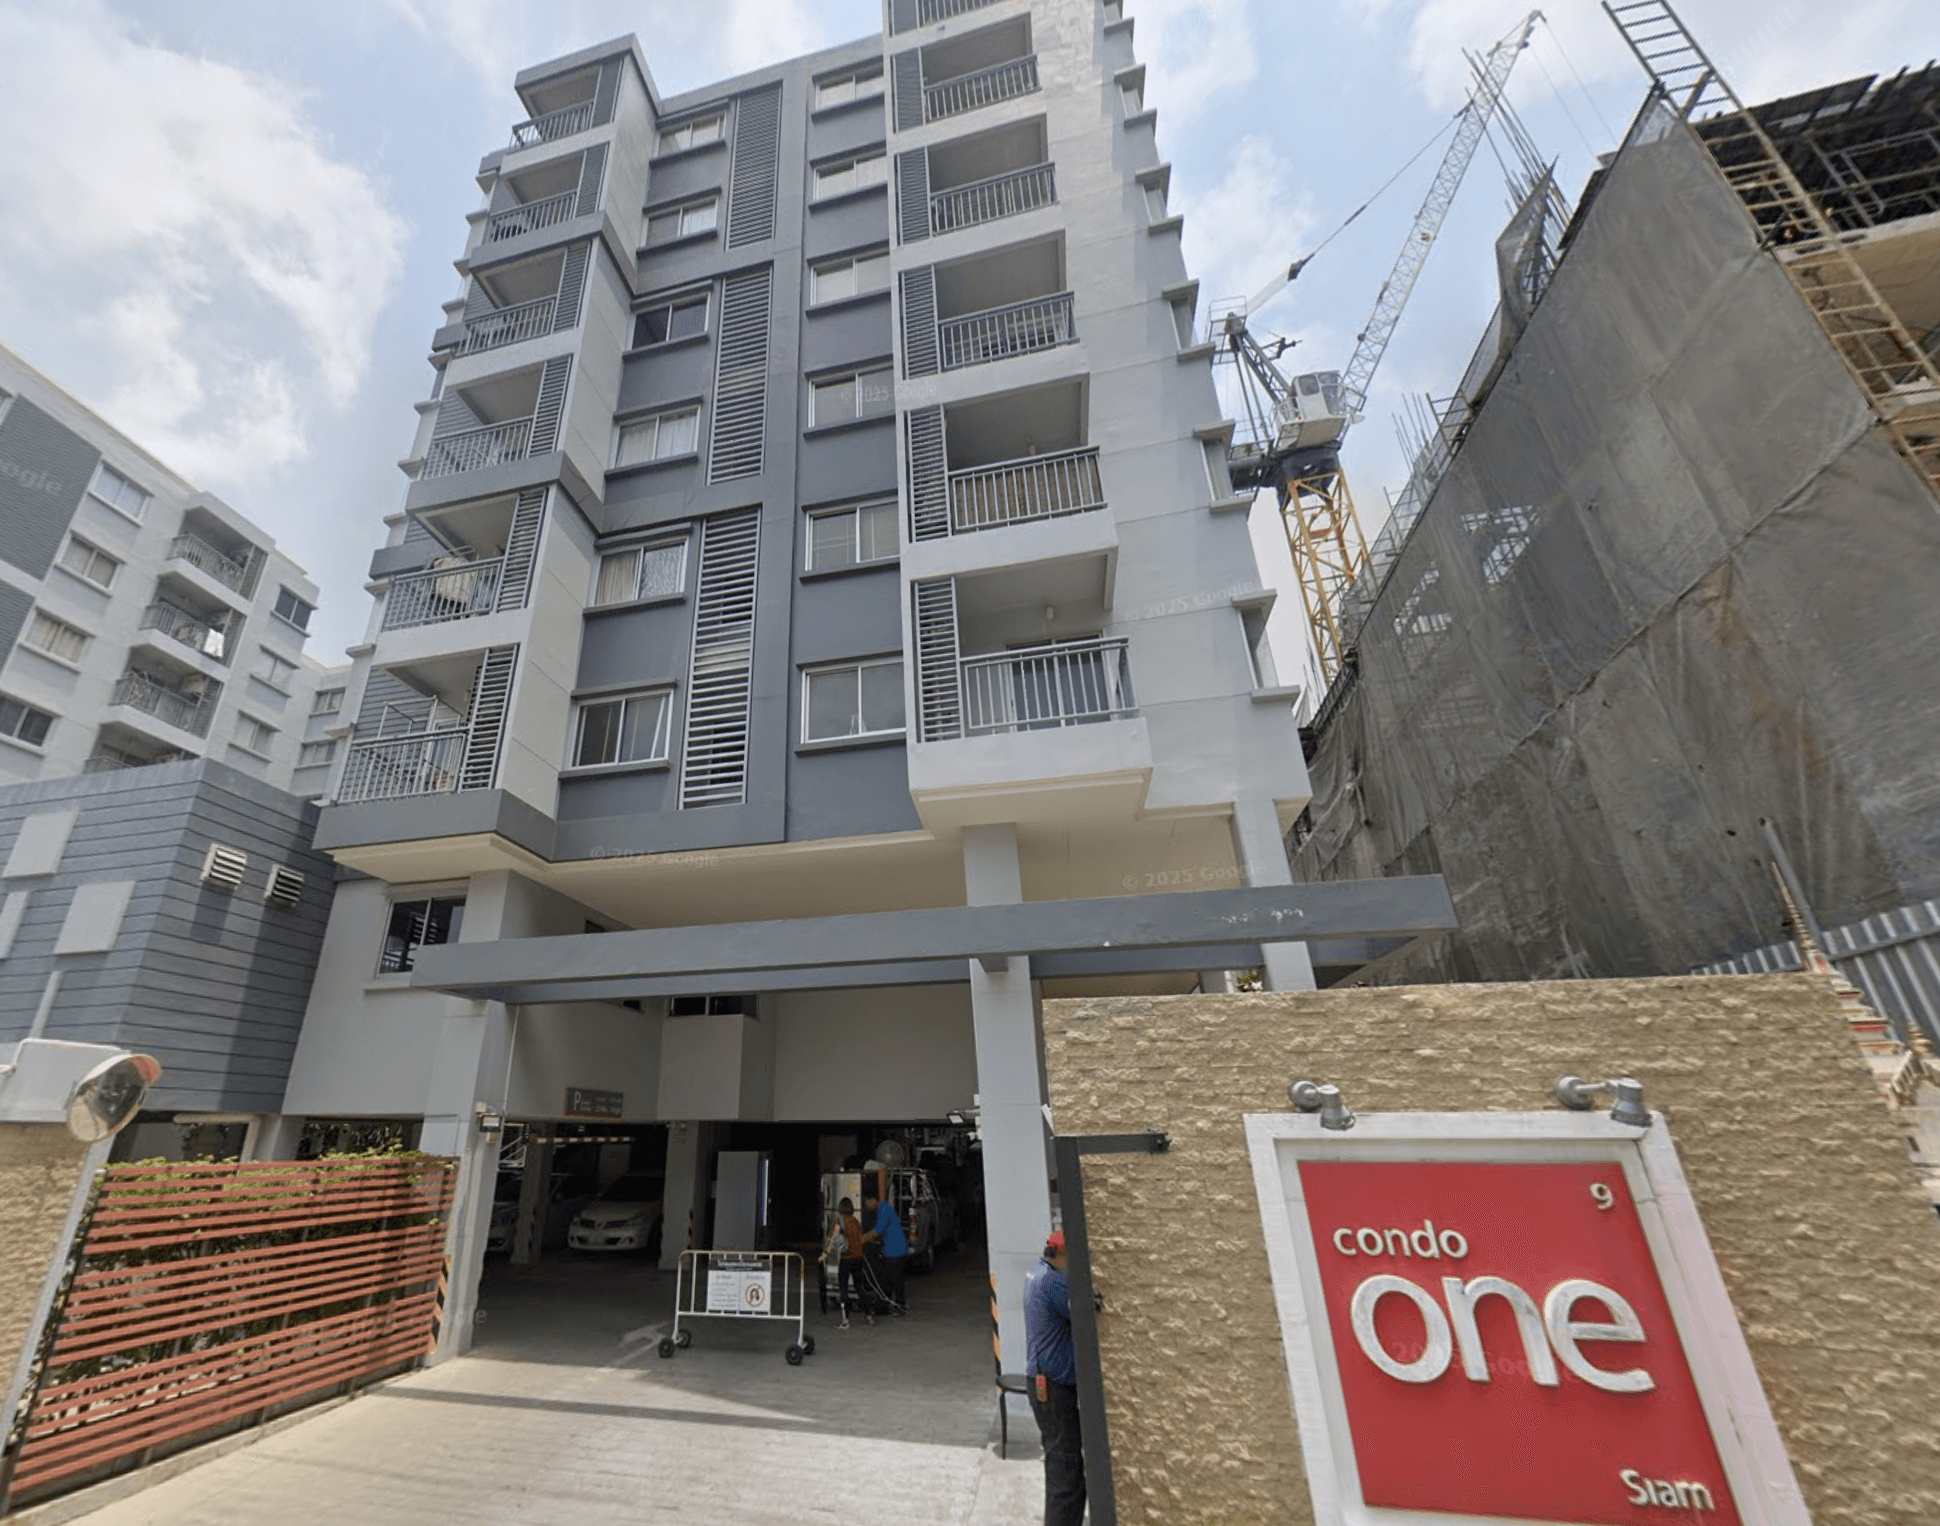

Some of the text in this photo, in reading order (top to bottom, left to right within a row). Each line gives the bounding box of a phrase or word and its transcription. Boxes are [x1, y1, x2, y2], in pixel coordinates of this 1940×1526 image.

[1589, 1182, 1614, 1210] 9
[1332, 1218, 1469, 1260] condo
[1350, 1273, 1656, 1394] one
[1619, 1468, 1716, 1512] Siam
